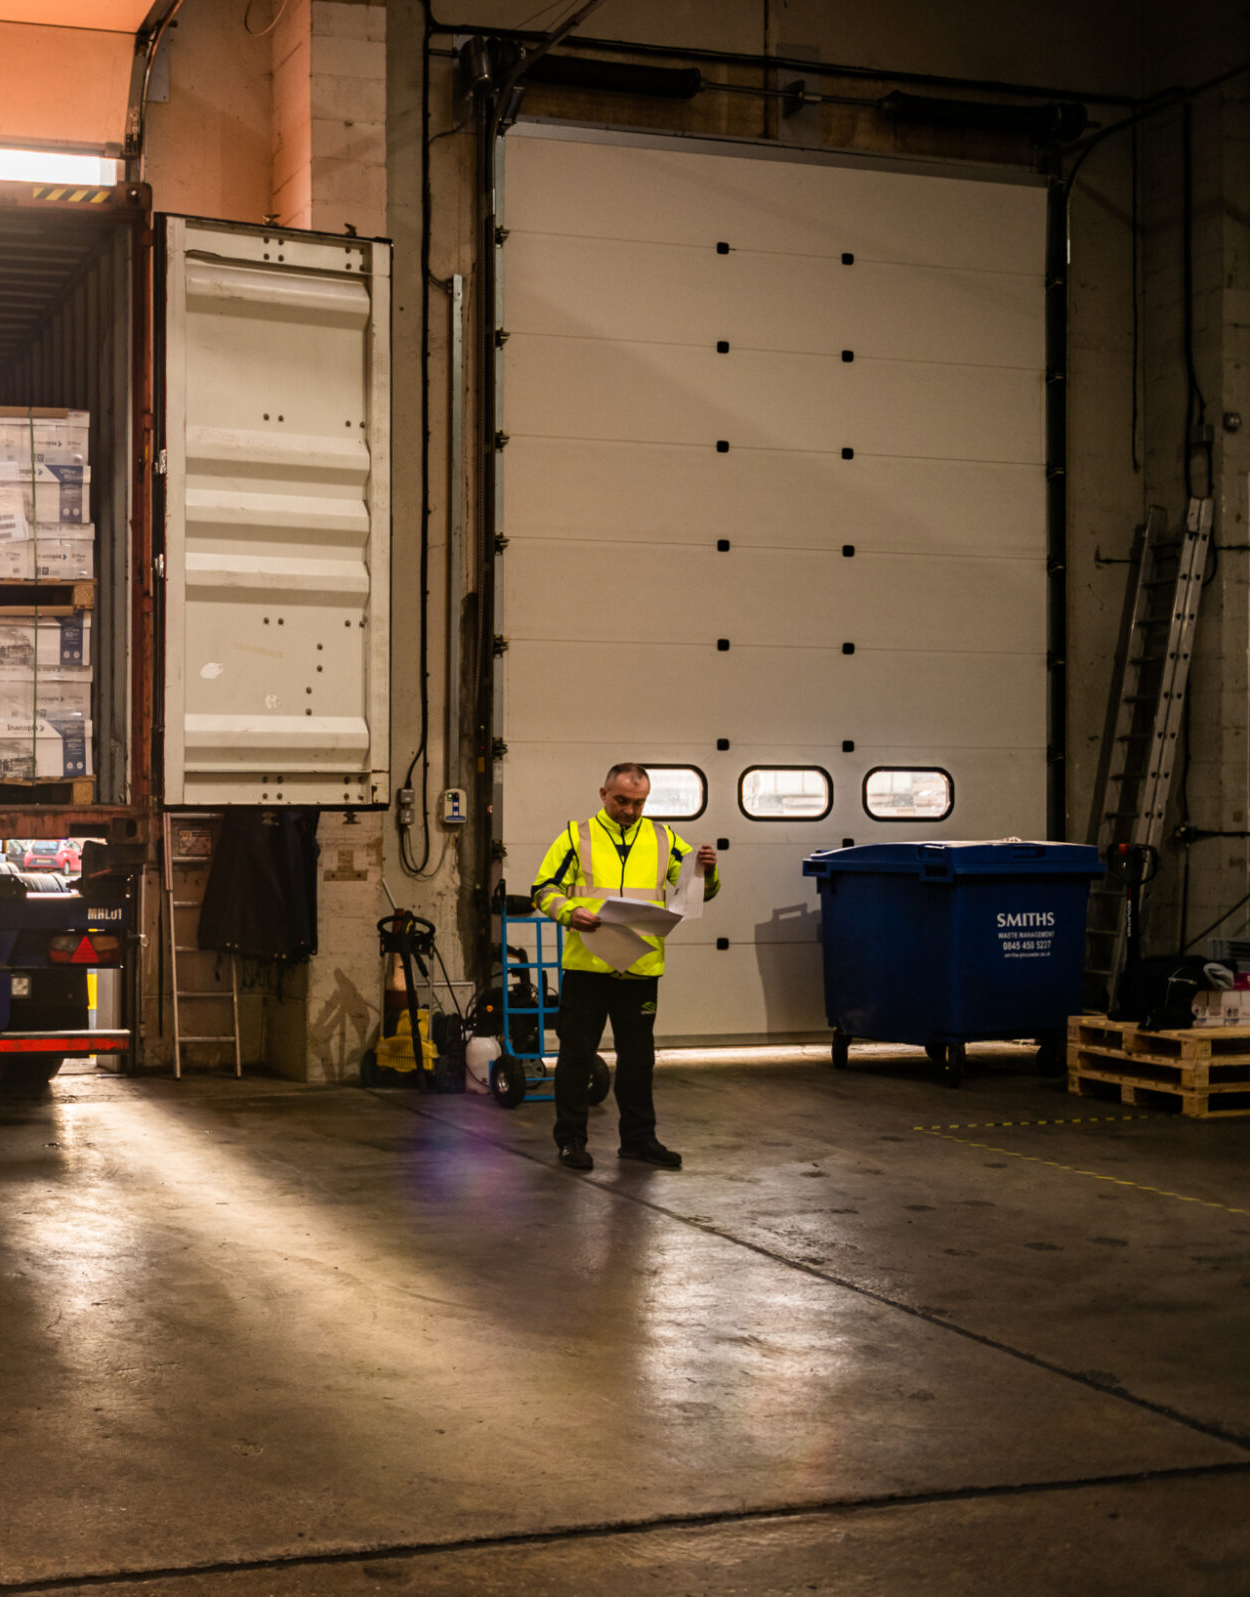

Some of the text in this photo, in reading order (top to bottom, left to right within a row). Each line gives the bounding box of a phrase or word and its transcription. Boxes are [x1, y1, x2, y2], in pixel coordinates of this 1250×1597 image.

[996, 912, 1055, 927] SMITHS
[998, 930, 1055, 939] WASTE MANAGEMENT
[1002, 941, 1020, 950] 0845
